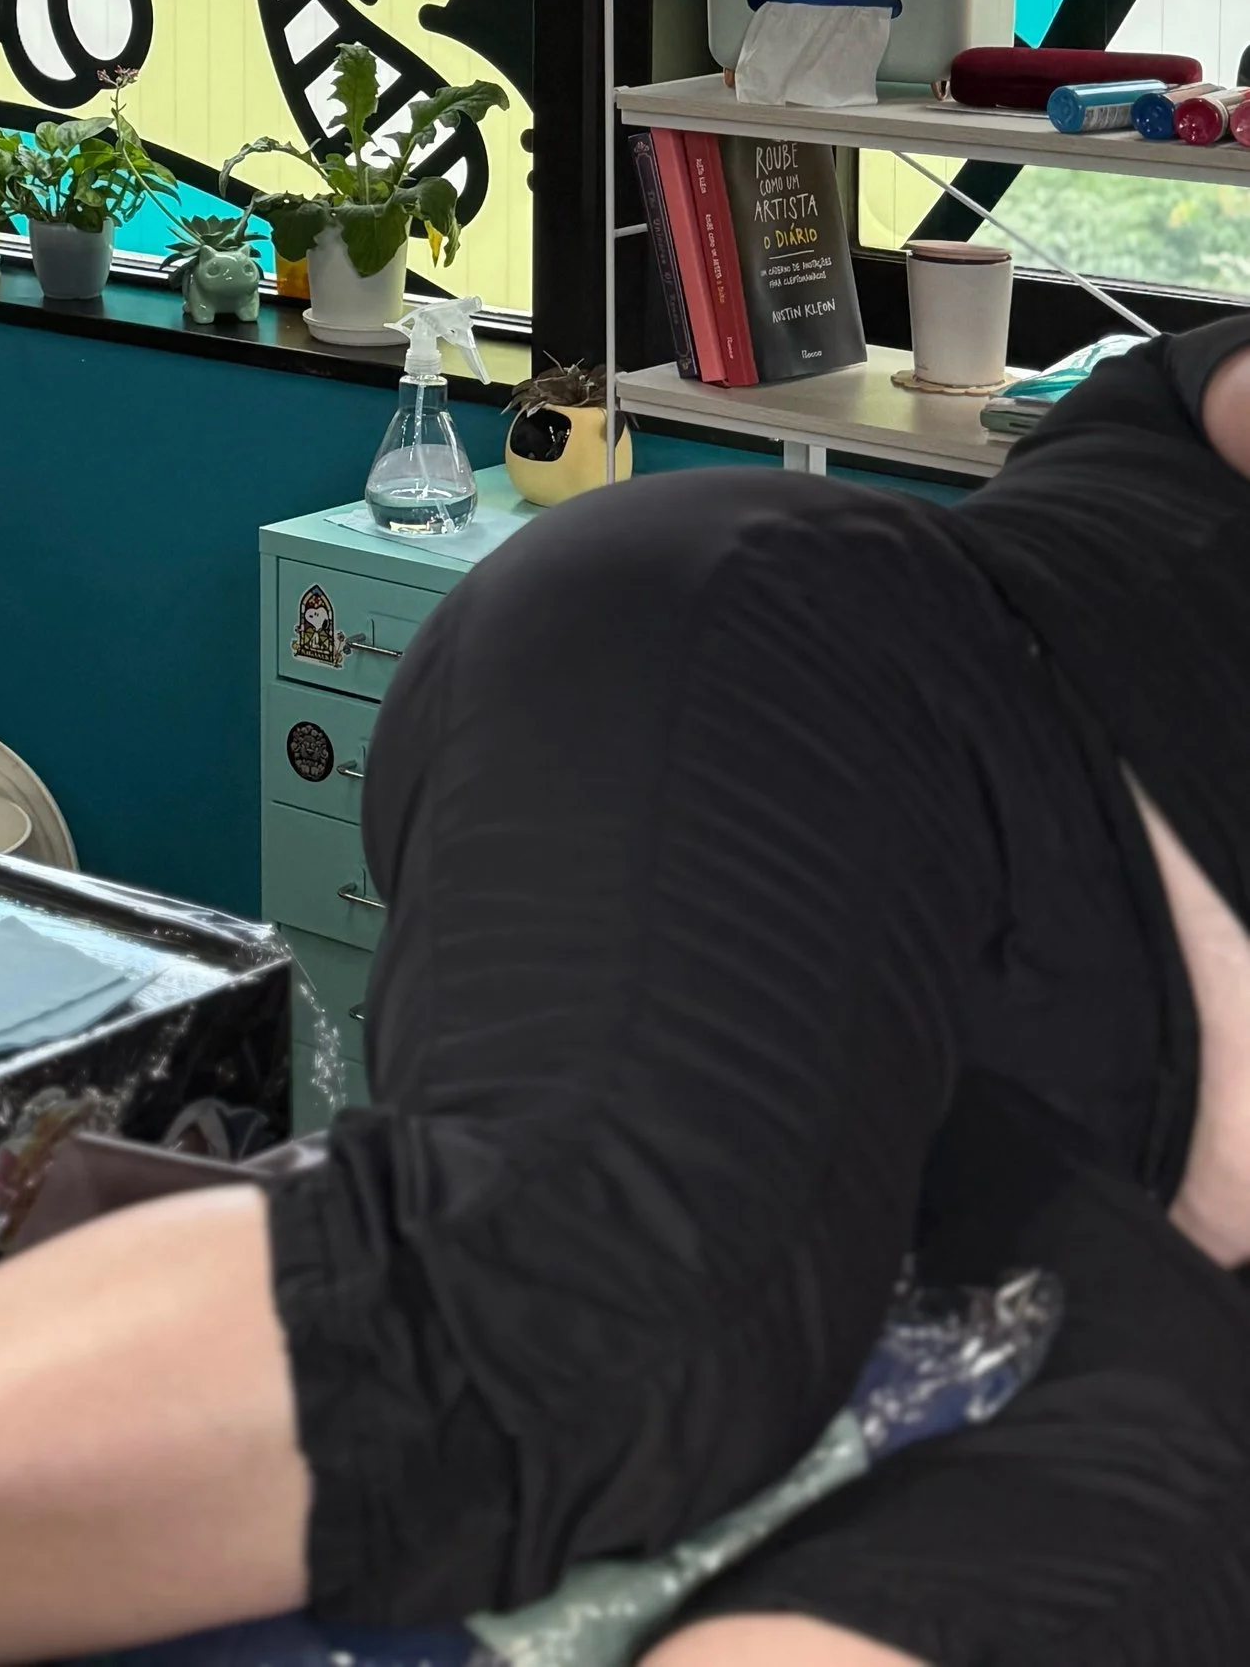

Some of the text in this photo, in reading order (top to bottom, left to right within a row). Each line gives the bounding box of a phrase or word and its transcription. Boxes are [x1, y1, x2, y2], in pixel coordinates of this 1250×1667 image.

[755, 142, 798, 179] ROUBE
[760, 174, 800, 197] COMO UM
[754, 193, 818, 222] ARTISTA
[775, 222, 818, 248] DIÁRIO
[772, 298, 836, 324] AUSTIN KLEON
